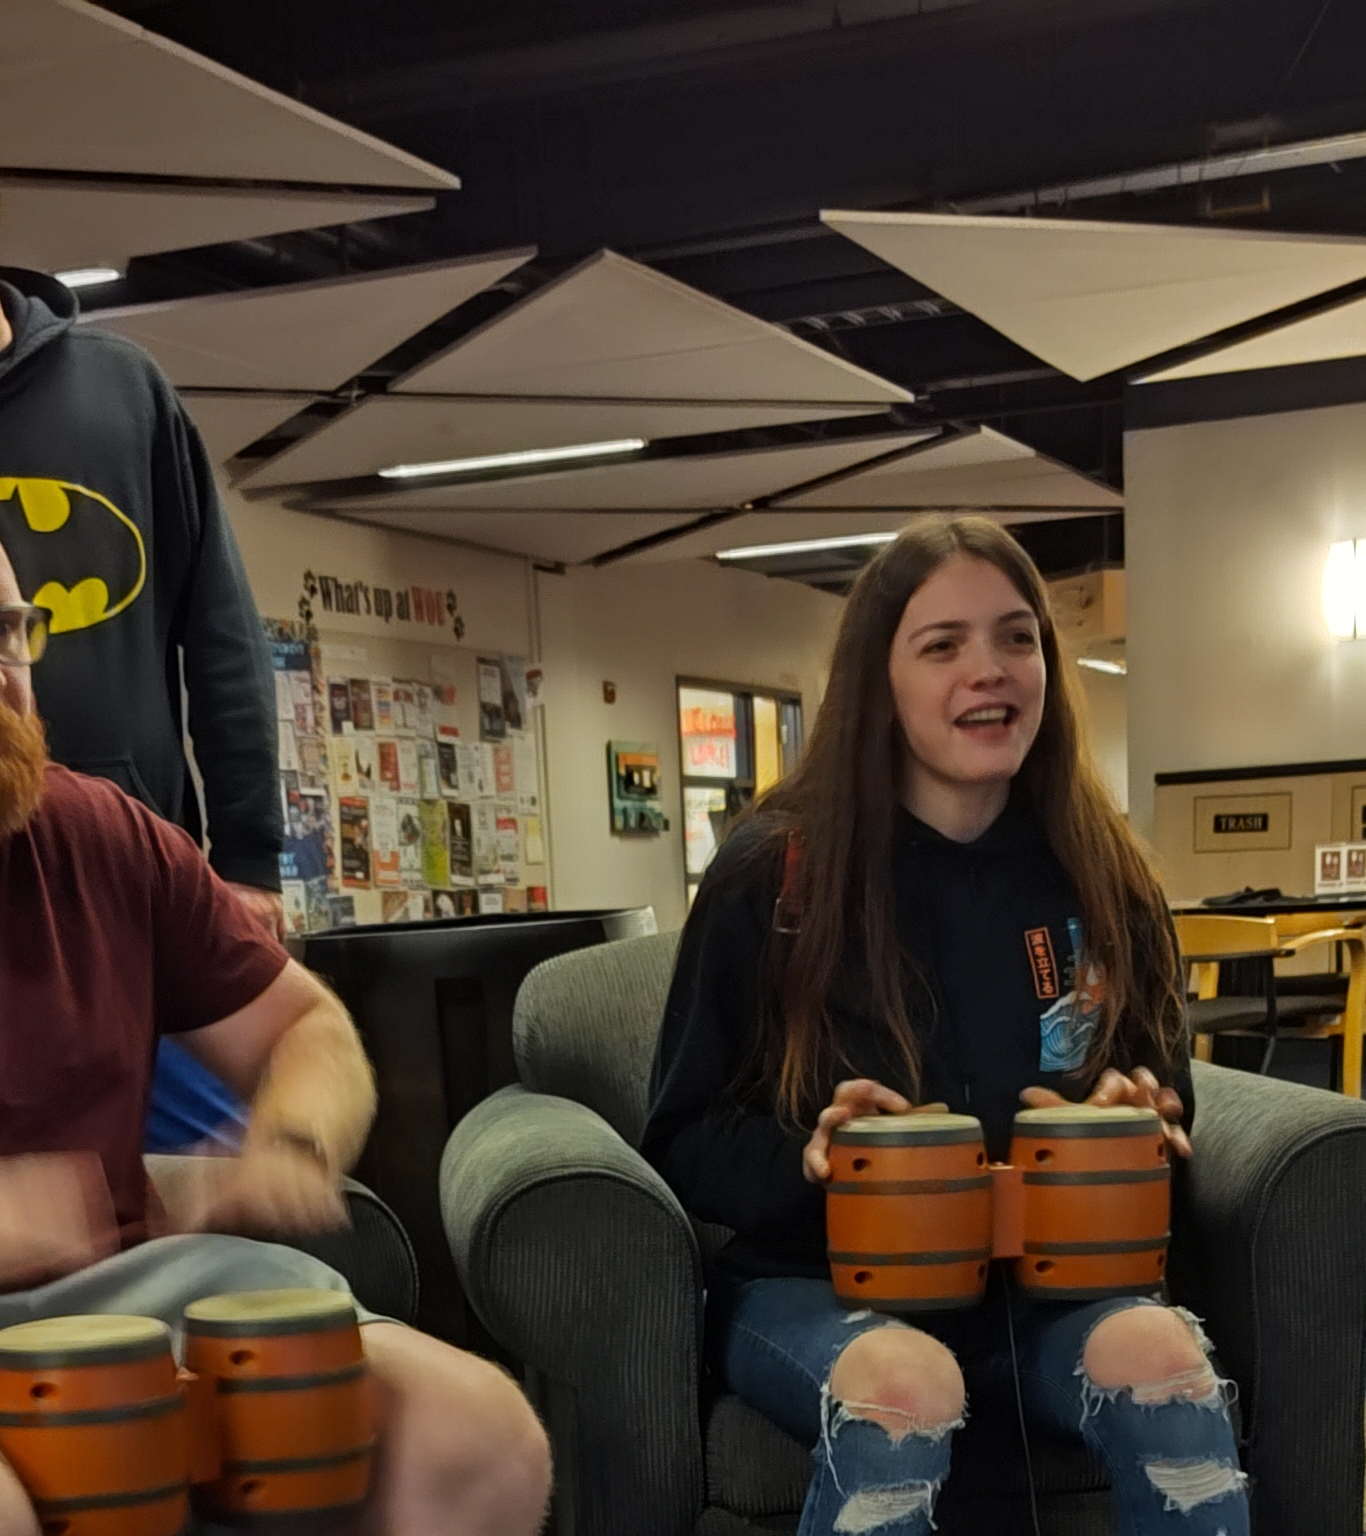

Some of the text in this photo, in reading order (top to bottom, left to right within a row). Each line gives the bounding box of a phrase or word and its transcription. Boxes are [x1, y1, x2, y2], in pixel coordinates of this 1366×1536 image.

[319, 576, 372, 614] What's
[373, 588, 392, 623] up
[396, 590, 411, 621] at
[1218, 816, 1263, 831] TRASH
